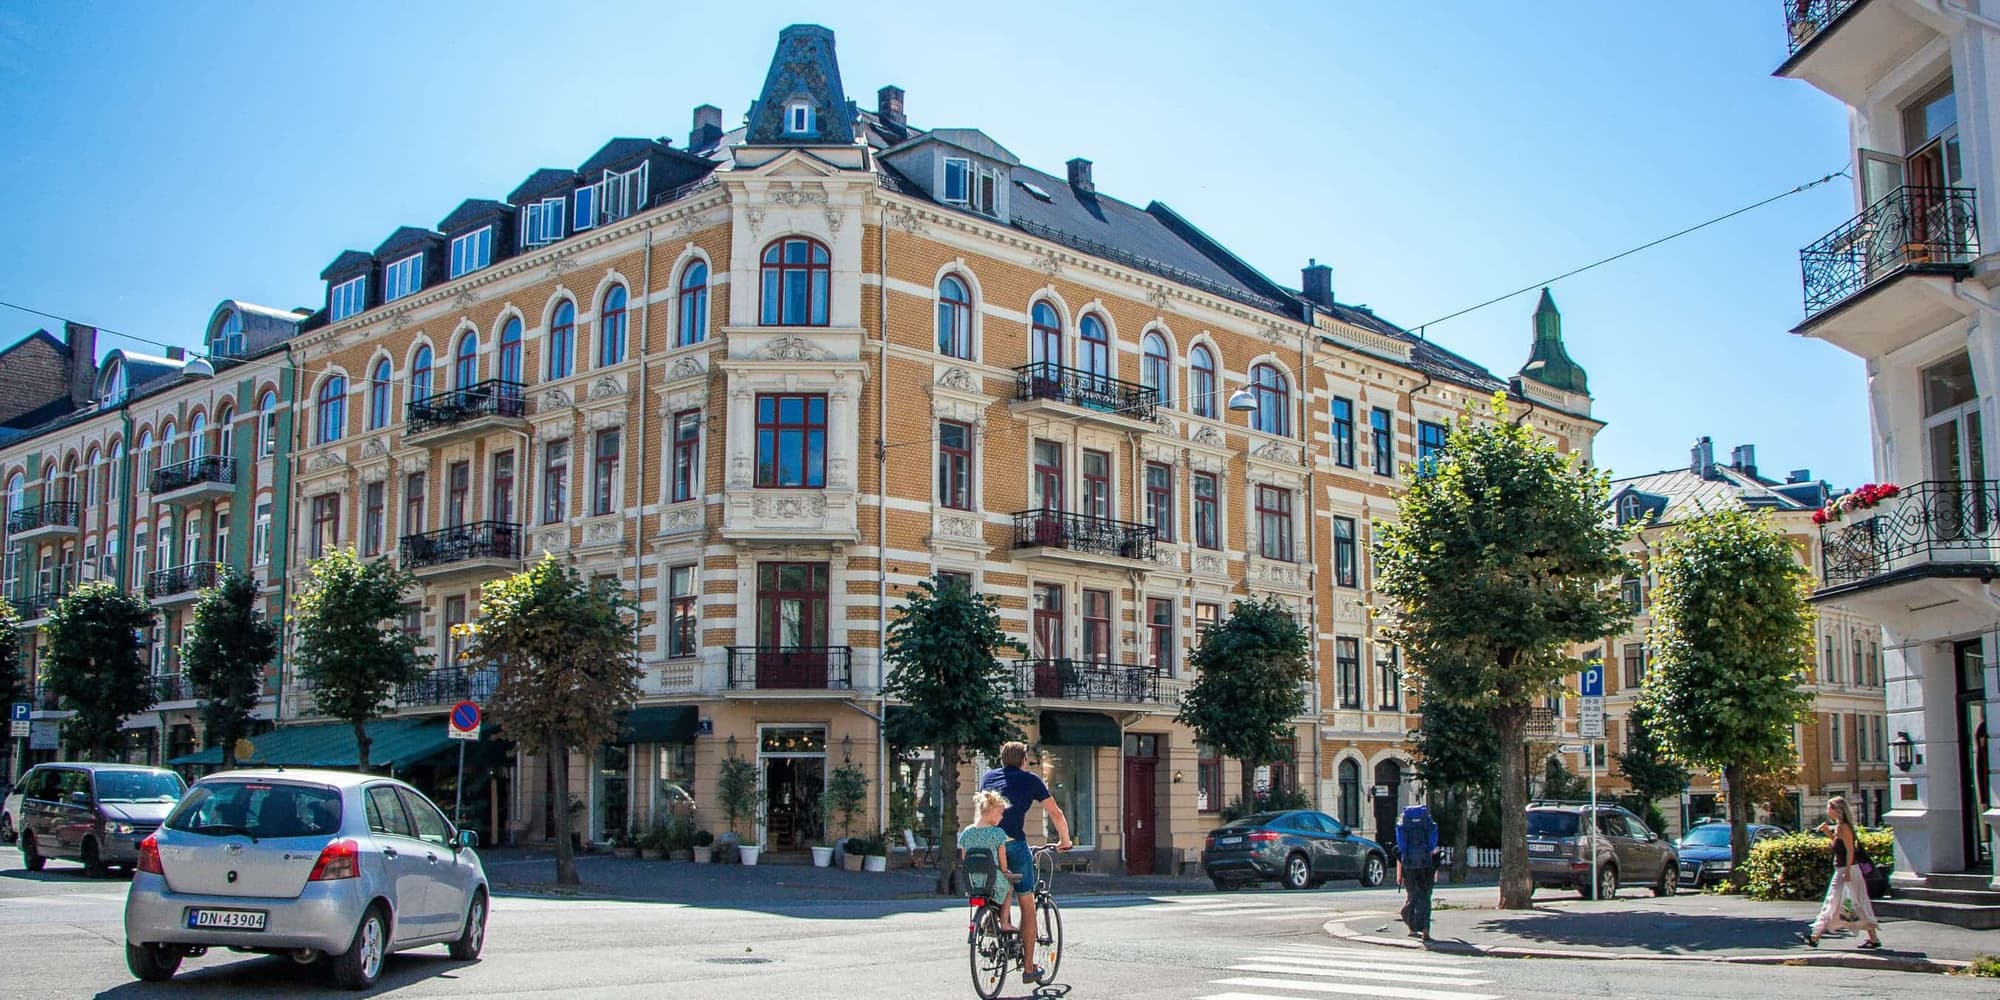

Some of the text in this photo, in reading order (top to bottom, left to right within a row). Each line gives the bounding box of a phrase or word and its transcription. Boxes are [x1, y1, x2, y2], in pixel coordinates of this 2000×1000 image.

[1586, 670, 1598, 692] P
[16, 705, 26, 718] P
[200, 911, 263, 927] DN 43904
